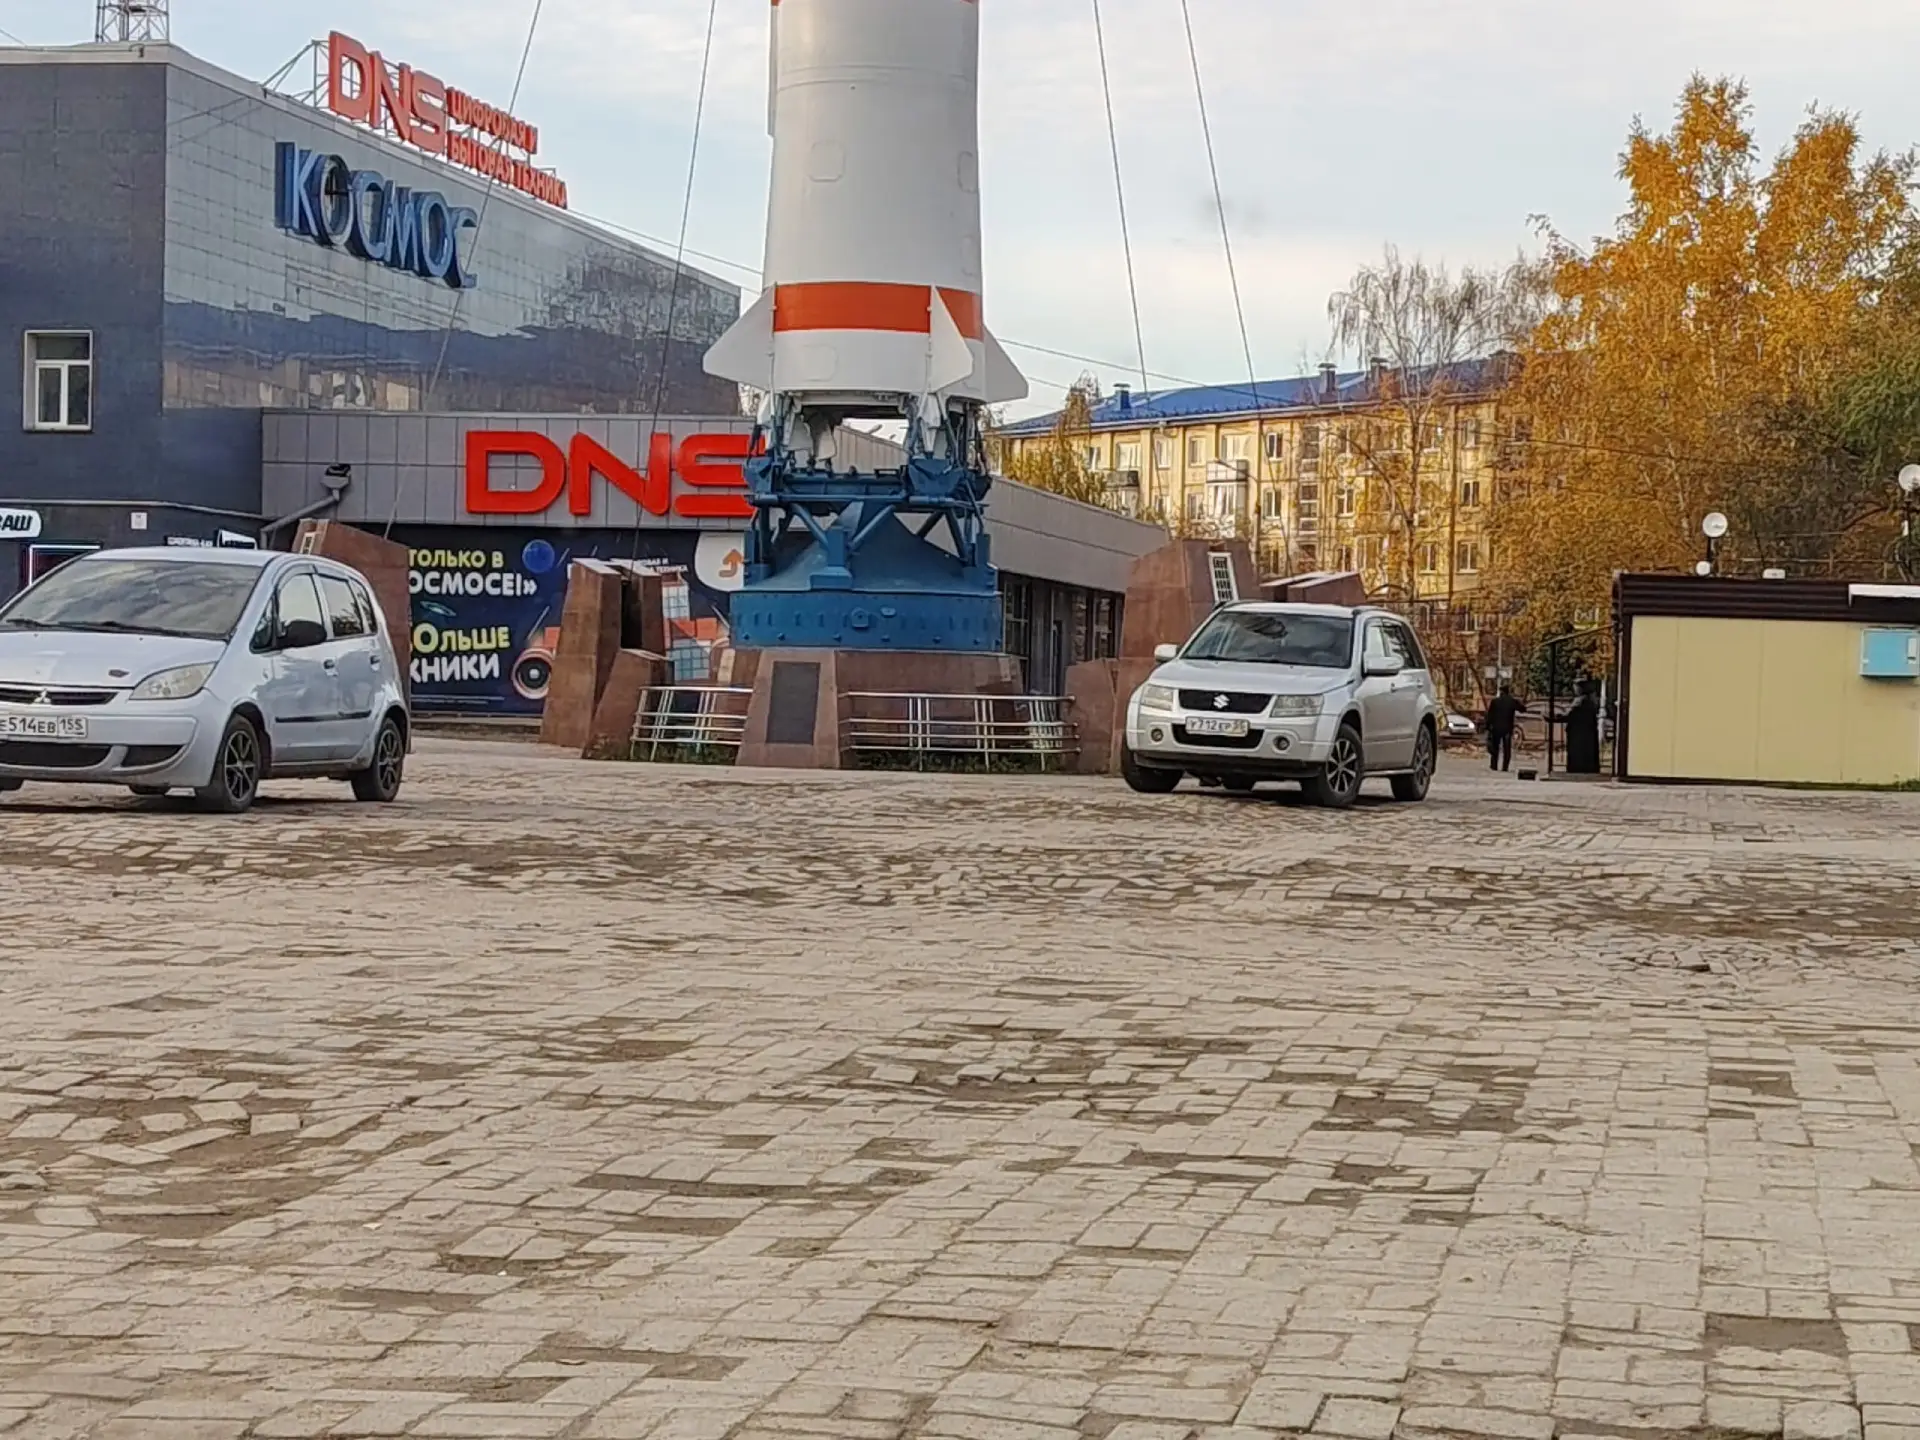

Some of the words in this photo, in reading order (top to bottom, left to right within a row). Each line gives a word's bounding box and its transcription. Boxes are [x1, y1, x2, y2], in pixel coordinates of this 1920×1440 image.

[328, 30, 446, 154] DNS
[446, 87, 526, 150] ЦИФРОВАЯ
[525, 125, 538, 155] И
[447, 131, 513, 186] БЫТОВАЯ
[512, 159, 568, 210] ТЕХНИКА
[275, 142, 478, 288] КОСМОС
[466, 431, 766, 517] DNS
[0, 514, 33, 531] АШ
[408, 548, 486, 568] ТОЛЬКО
[491, 551, 504, 568] В
[410, 623, 510, 653] ОЛЬШЕ
